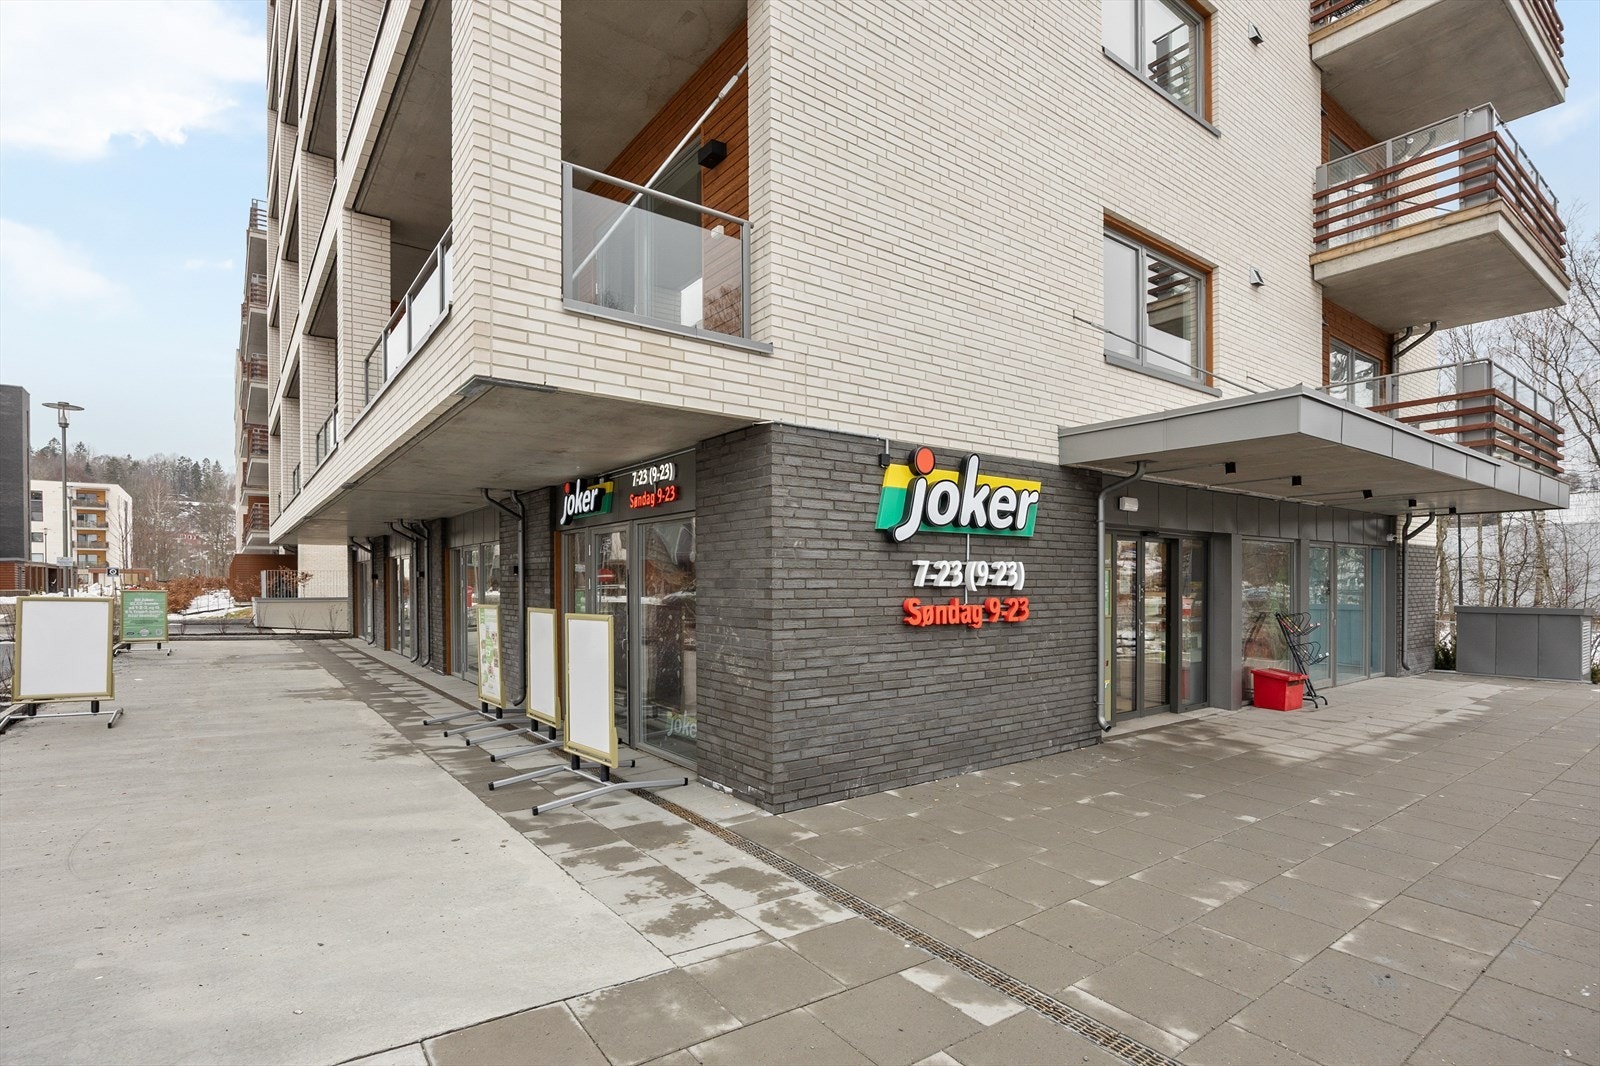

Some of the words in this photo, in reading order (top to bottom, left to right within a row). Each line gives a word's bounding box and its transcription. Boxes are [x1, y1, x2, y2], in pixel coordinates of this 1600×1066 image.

[632, 468, 648, 487] 7-23
[649, 462, 676, 485] (9-23)
[560, 478, 599, 525] joker
[629, 490, 656, 509] Søndag
[656, 485, 678, 503] 9-23
[892, 446, 1040, 543] joker
[912, 560, 963, 587] 7-23
[964, 561, 1026, 591] (9-23)
[903, 597, 983, 629] Søndag
[984, 597, 1030, 623] 9-23
